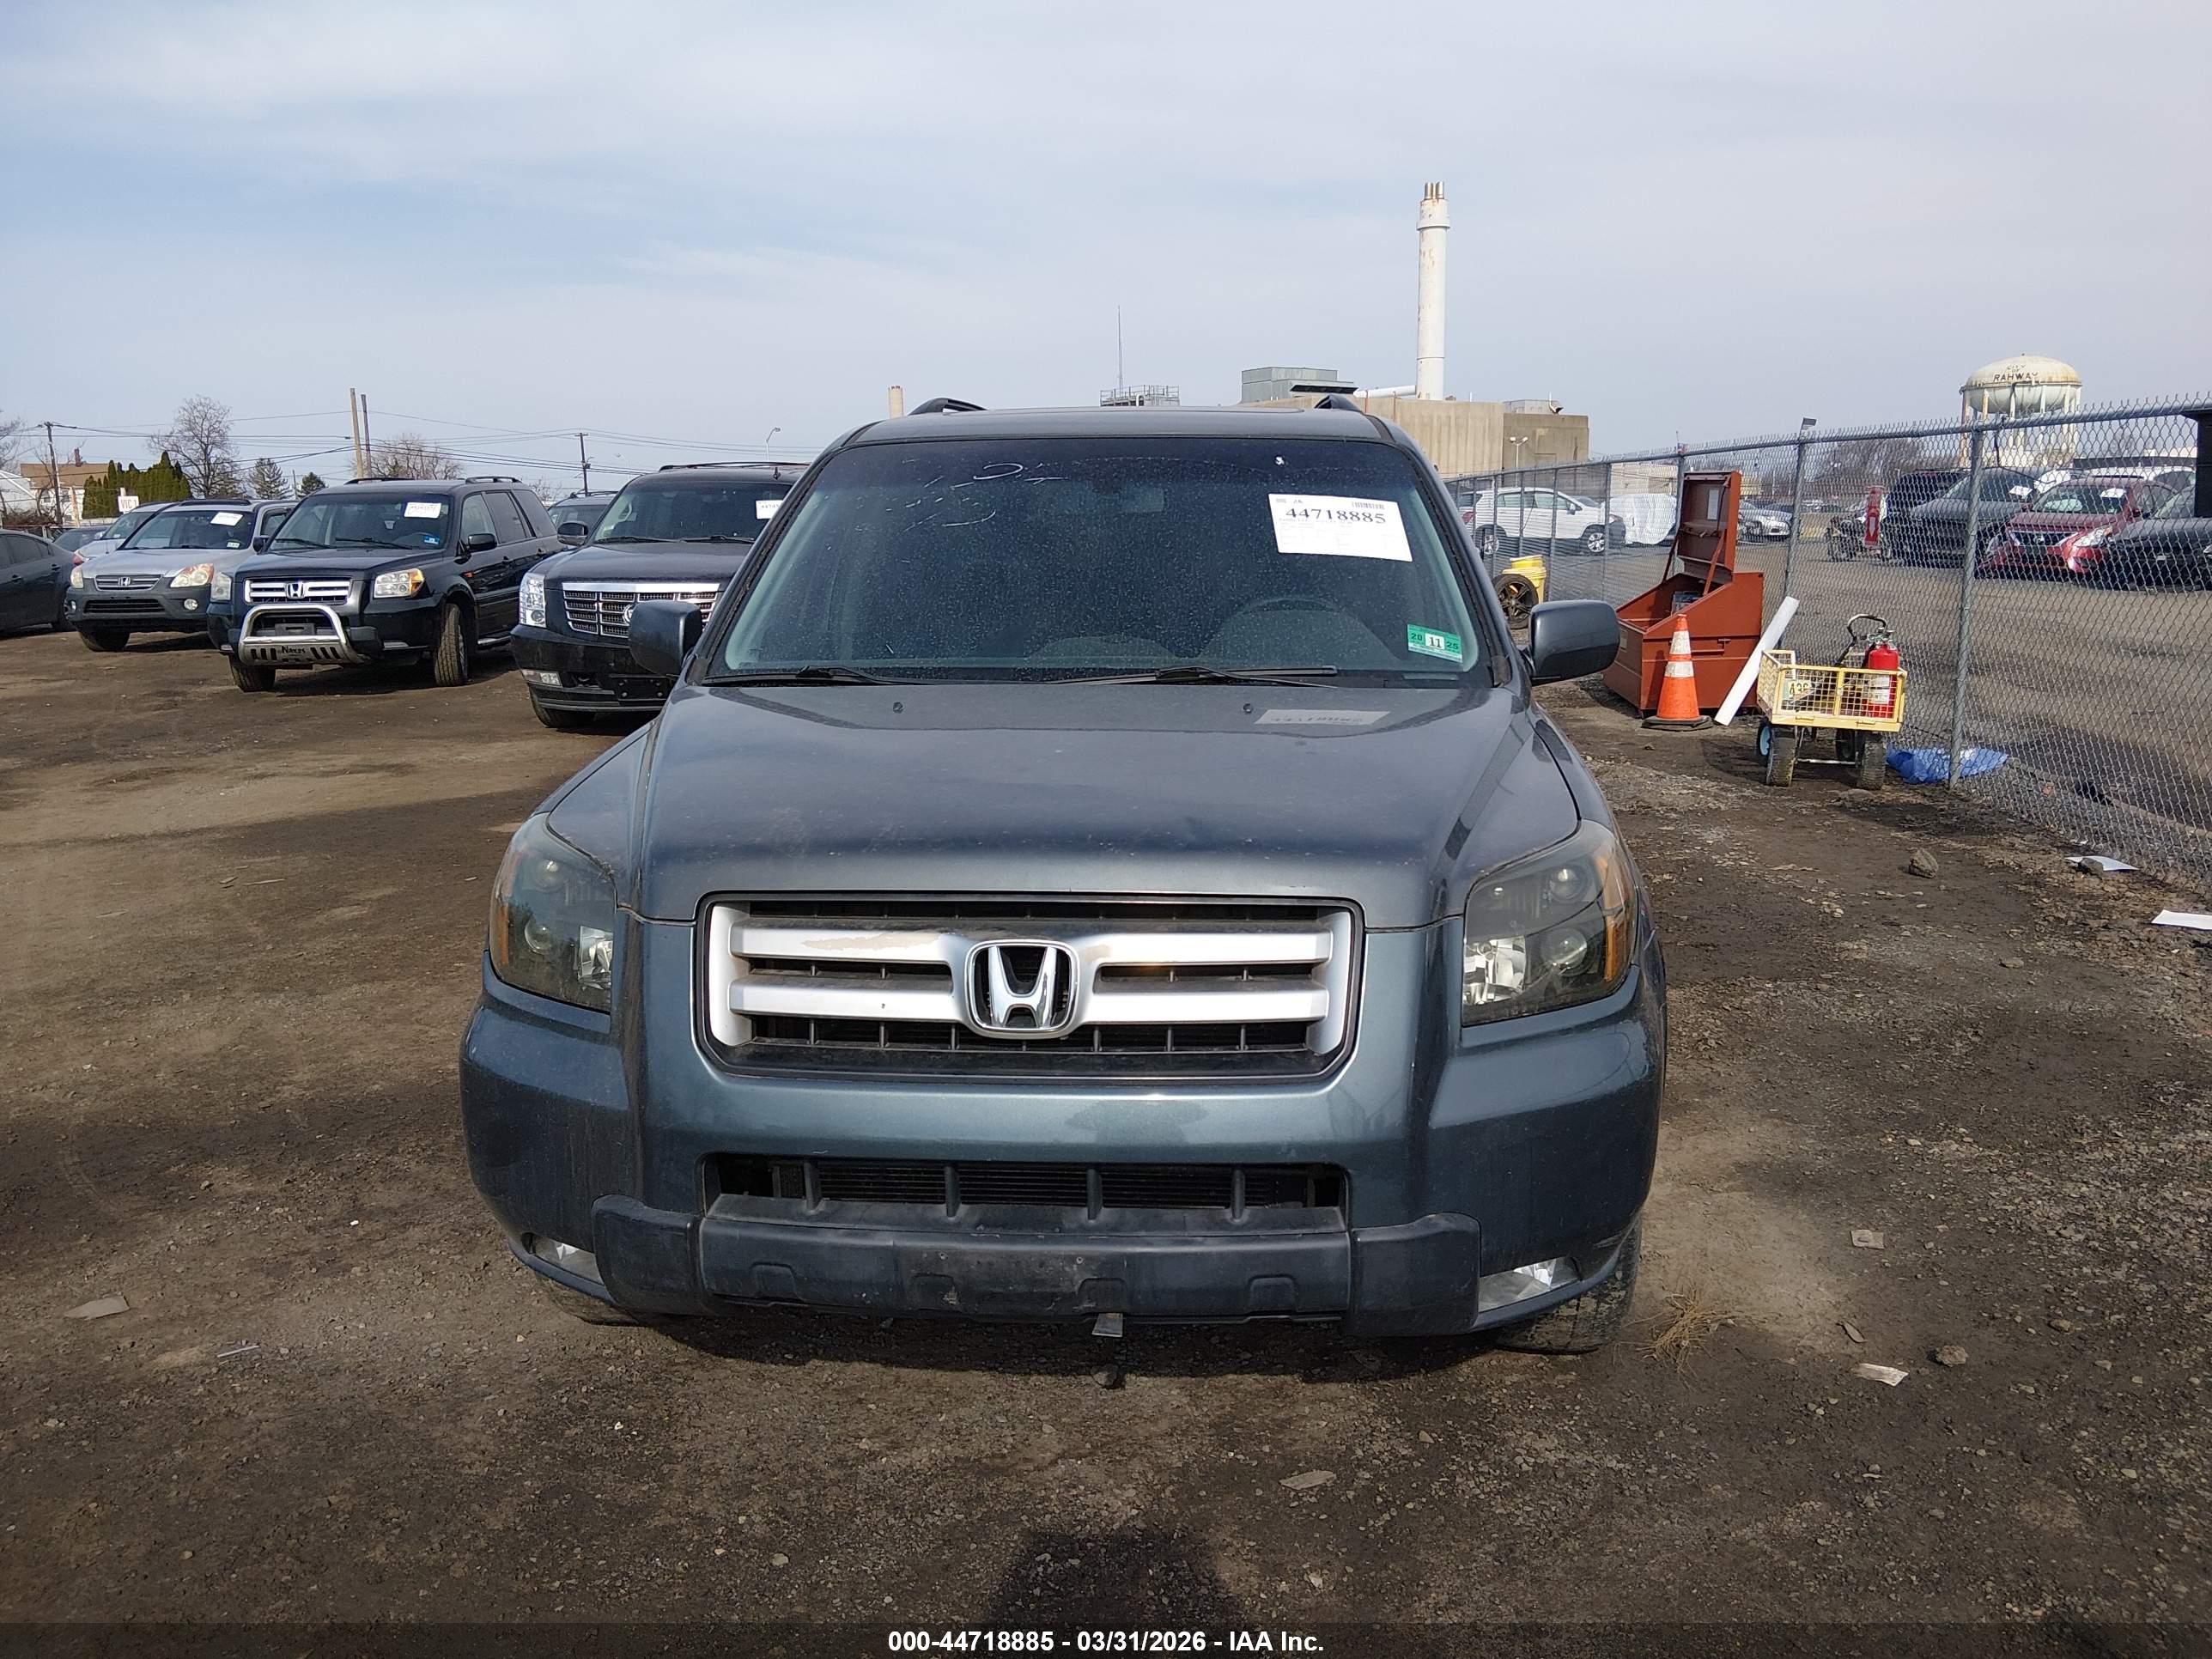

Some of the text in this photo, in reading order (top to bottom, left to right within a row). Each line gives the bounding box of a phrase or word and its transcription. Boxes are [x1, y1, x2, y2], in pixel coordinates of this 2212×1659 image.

[1993, 372, 2039, 382] RAHWAY
[1285, 507, 1386, 525] 44718885
[1411, 633, 1423, 641] 20
[1429, 636, 1442, 648] 11
[1446, 641, 1459, 650] 25
